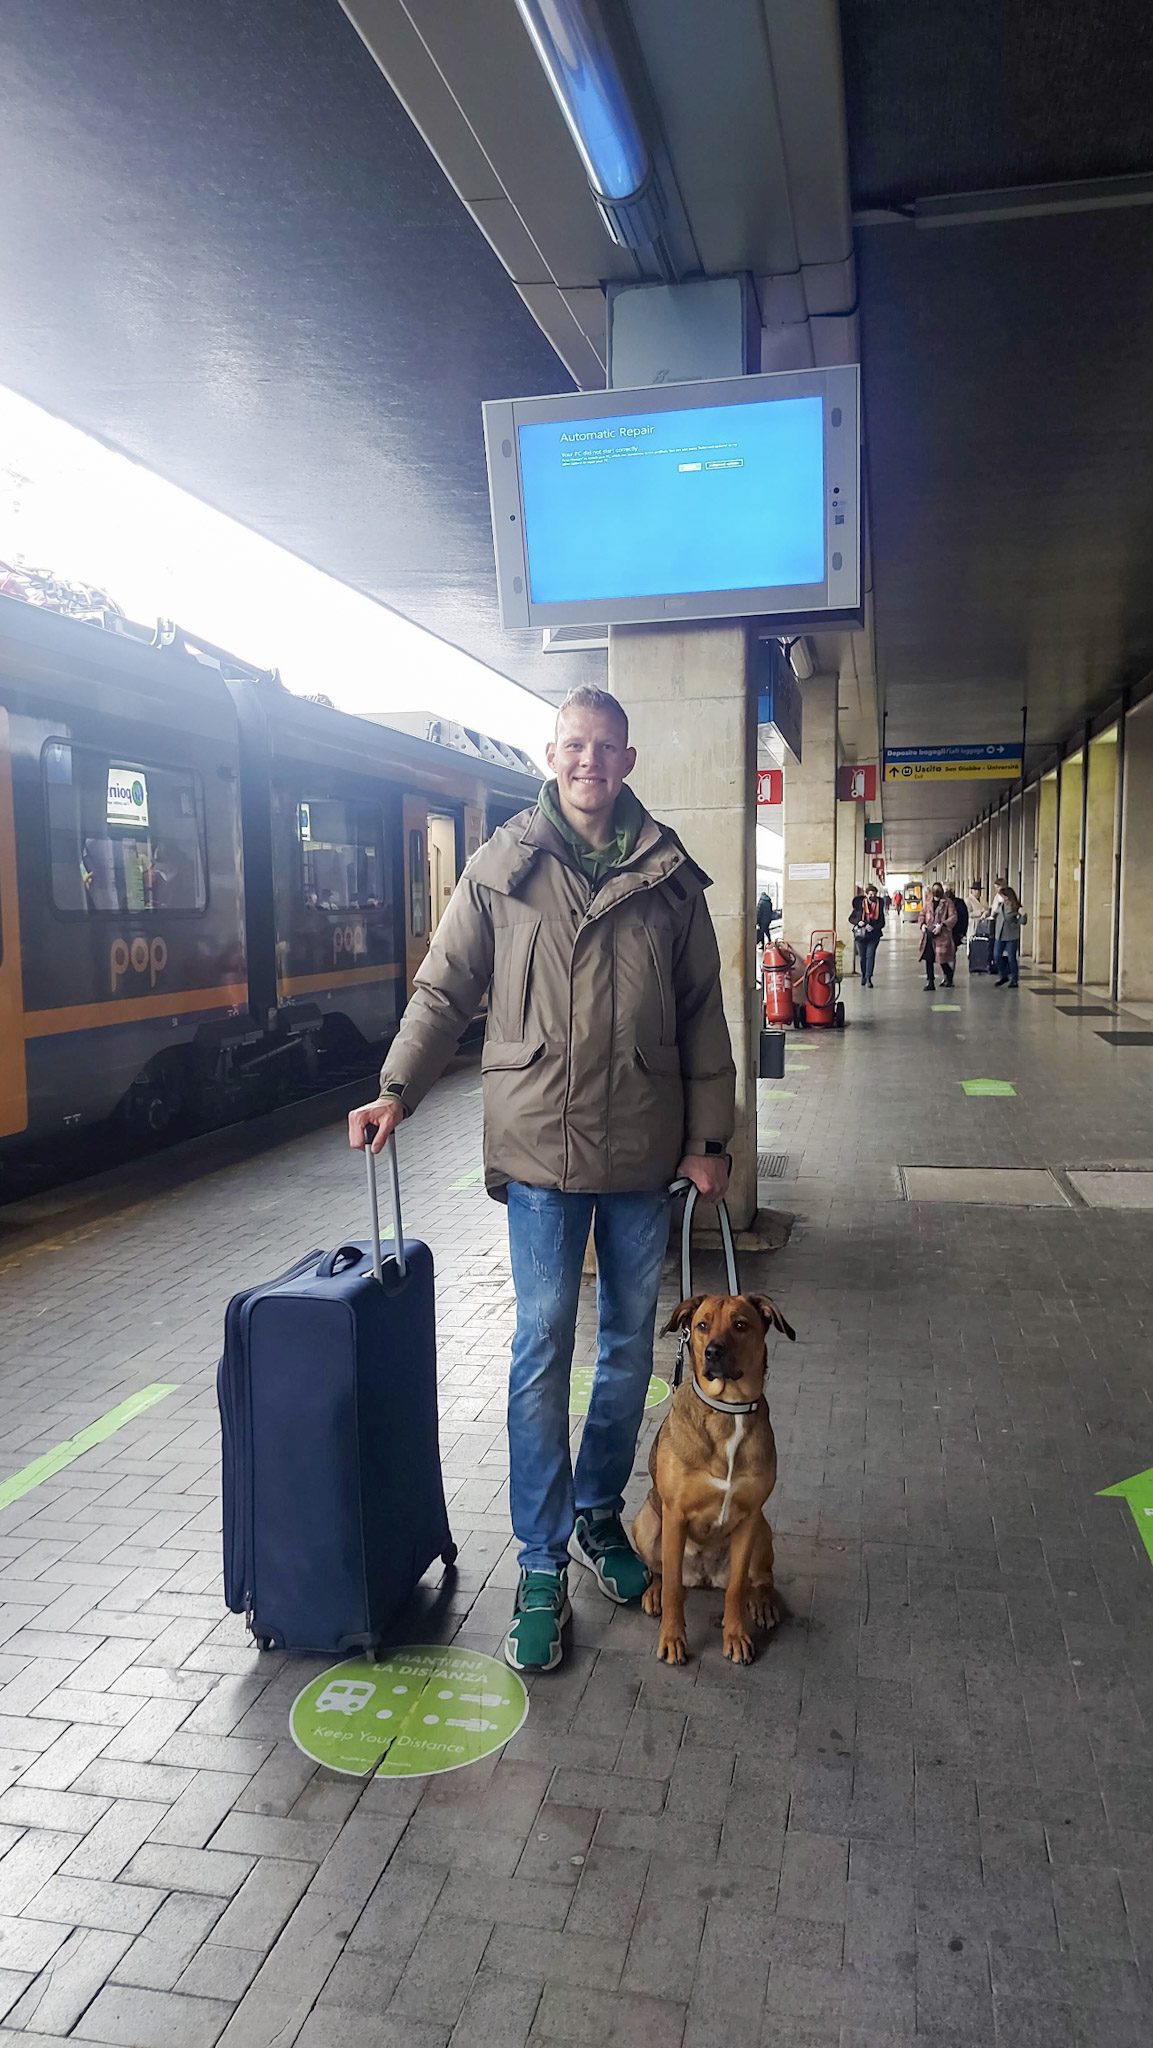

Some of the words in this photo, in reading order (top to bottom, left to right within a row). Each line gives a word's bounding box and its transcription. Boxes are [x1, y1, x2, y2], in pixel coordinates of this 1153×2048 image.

[560, 429, 615, 443] Automatic
[619, 425, 655, 438] Repair
[915, 765, 942, 773] Uscita
[333, 925, 364, 965] pop
[110, 935, 168, 993] pop
[371, 1663, 394, 1673] LA
[393, 1653, 484, 1670] MANTIENI
[313, 1726, 354, 1741] Keep
[359, 1731, 394, 1745] Your
[397, 1735, 465, 1753] Distance
